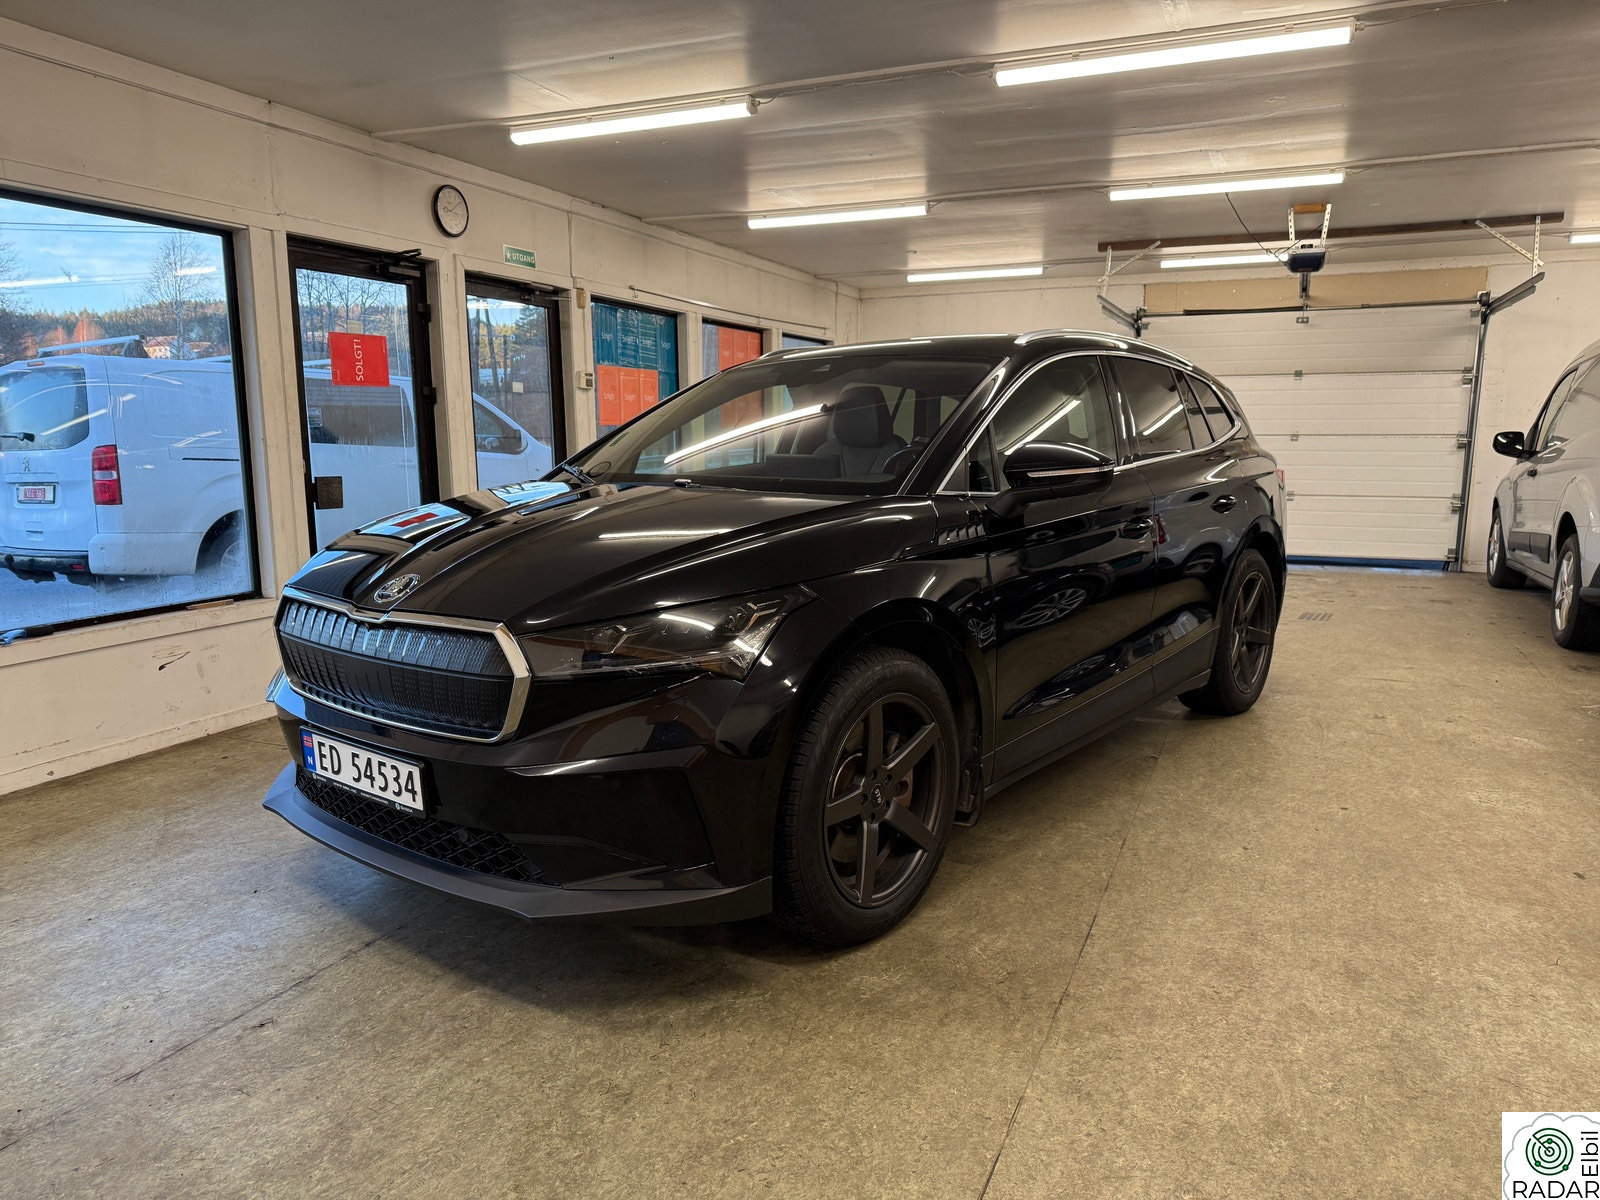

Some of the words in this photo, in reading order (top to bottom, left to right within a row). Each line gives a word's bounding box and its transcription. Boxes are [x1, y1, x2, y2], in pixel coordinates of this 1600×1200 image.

[512, 252, 535, 264] UTGANG
[353, 339, 364, 381] SOLGT!
[307, 755, 313, 765] N
[317, 740, 341, 776] ED
[351, 751, 418, 804] 54534
